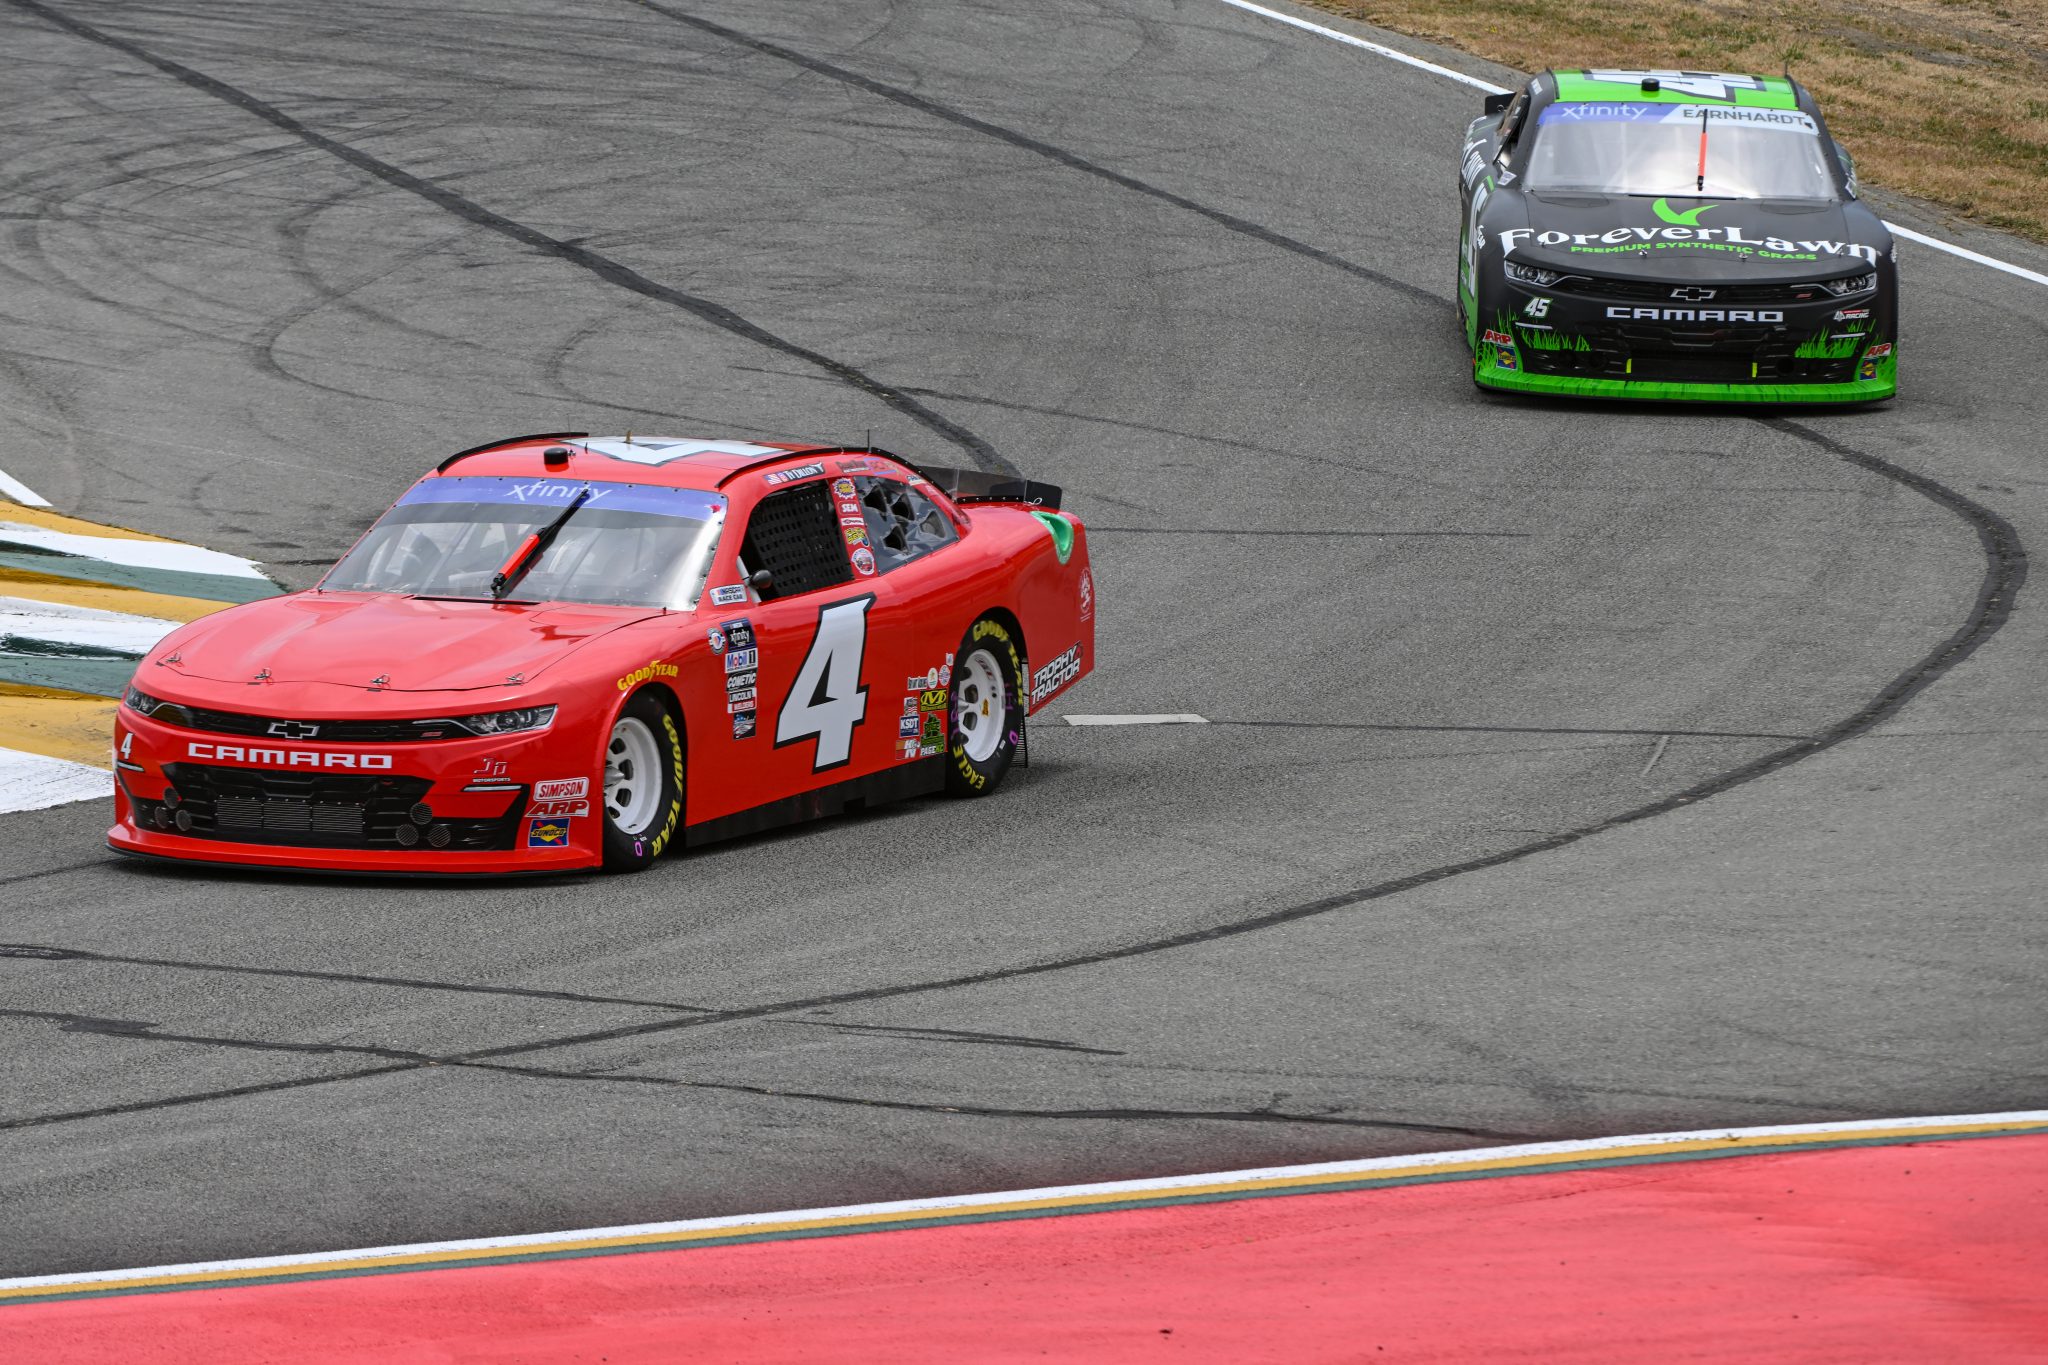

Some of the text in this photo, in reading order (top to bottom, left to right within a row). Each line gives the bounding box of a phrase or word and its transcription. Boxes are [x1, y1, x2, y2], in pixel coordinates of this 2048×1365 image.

[1561, 103, 1648, 120] xfinity
[1683, 108, 1806, 126] EARNHARDT
[1498, 226, 1877, 268] ForeverLawn
[1571, 241, 1817, 260] PREMIUM SYNTHETIC GRASS
[1525, 298, 1550, 317] 45
[1606, 306, 1784, 323] CAMARO
[1485, 331, 1511, 344] ARP
[1867, 344, 1891, 356] ARP
[506, 480, 613, 502] xfinity
[841, 503, 859, 513] SEM
[727, 651, 748, 669] Mobil
[1033, 644, 1078, 688] TROPHY
[617, 660, 679, 691] GOODYEAR
[727, 672, 756, 689] COMETIC
[776, 597, 874, 770] 4
[1030, 657, 1081, 705] TRACTOR
[729, 689, 752, 704] LINCOLN
[900, 718, 919, 730] KSDT
[120, 732, 134, 760] 4
[187, 742, 392, 769] CAMARO
[953, 744, 986, 790] EAGLE
[538, 781, 584, 799] SIMPSON
[527, 801, 589, 817] ARP
[531, 827, 567, 838] SUNOCO
